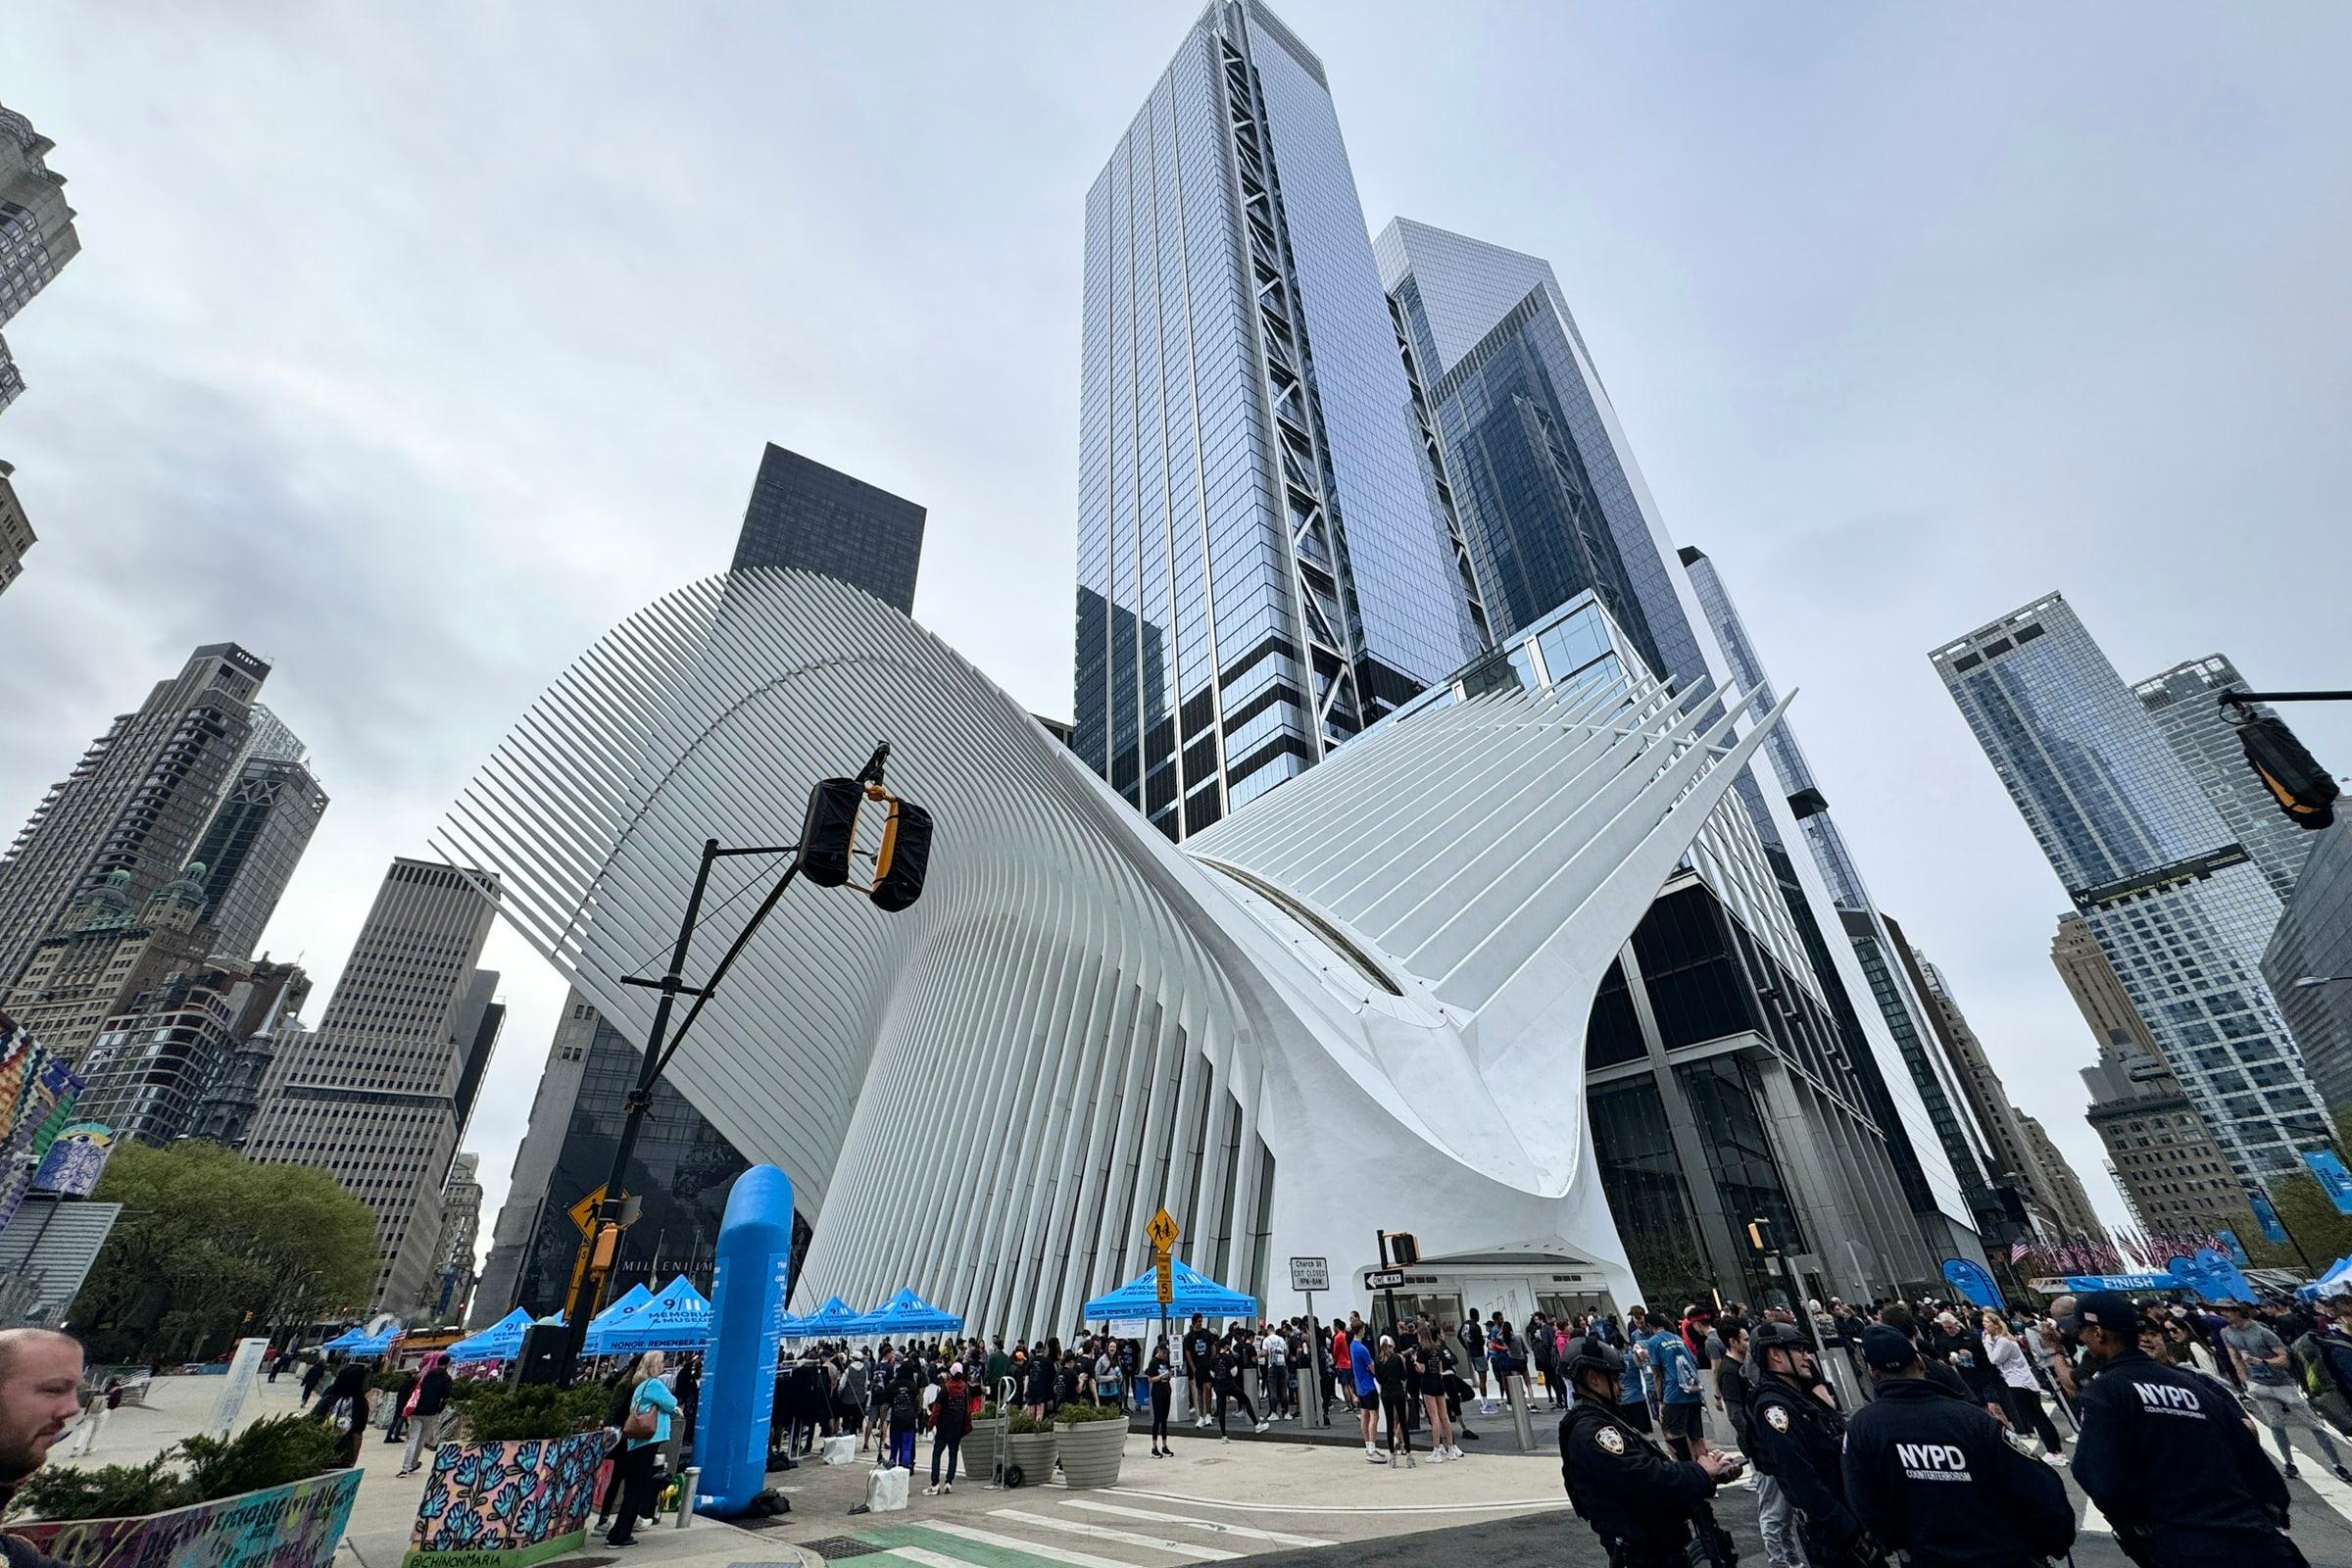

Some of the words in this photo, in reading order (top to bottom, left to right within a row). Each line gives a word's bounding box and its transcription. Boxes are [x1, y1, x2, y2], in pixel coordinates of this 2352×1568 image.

[2074, 894, 2088, 904] W
[622, 1261, 712, 1271] MILENIUM
[1373, 1276, 1385, 1285] ONE
[1387, 1275, 1401, 1284] WAY
[2102, 1277, 2156, 1288] FINISH
[1161, 1283, 1168, 1294] 5
[662, 1297, 701, 1311] 9/11
[901, 1300, 922, 1309] 9/11
[2132, 1383, 2199, 1410] NYPD
[1896, 1444, 1966, 1470] NYPD
[1906, 1470, 1973, 1482] COUNTERTERRORISM
[410, 1554, 501, 1568] @CHINONMARIA
